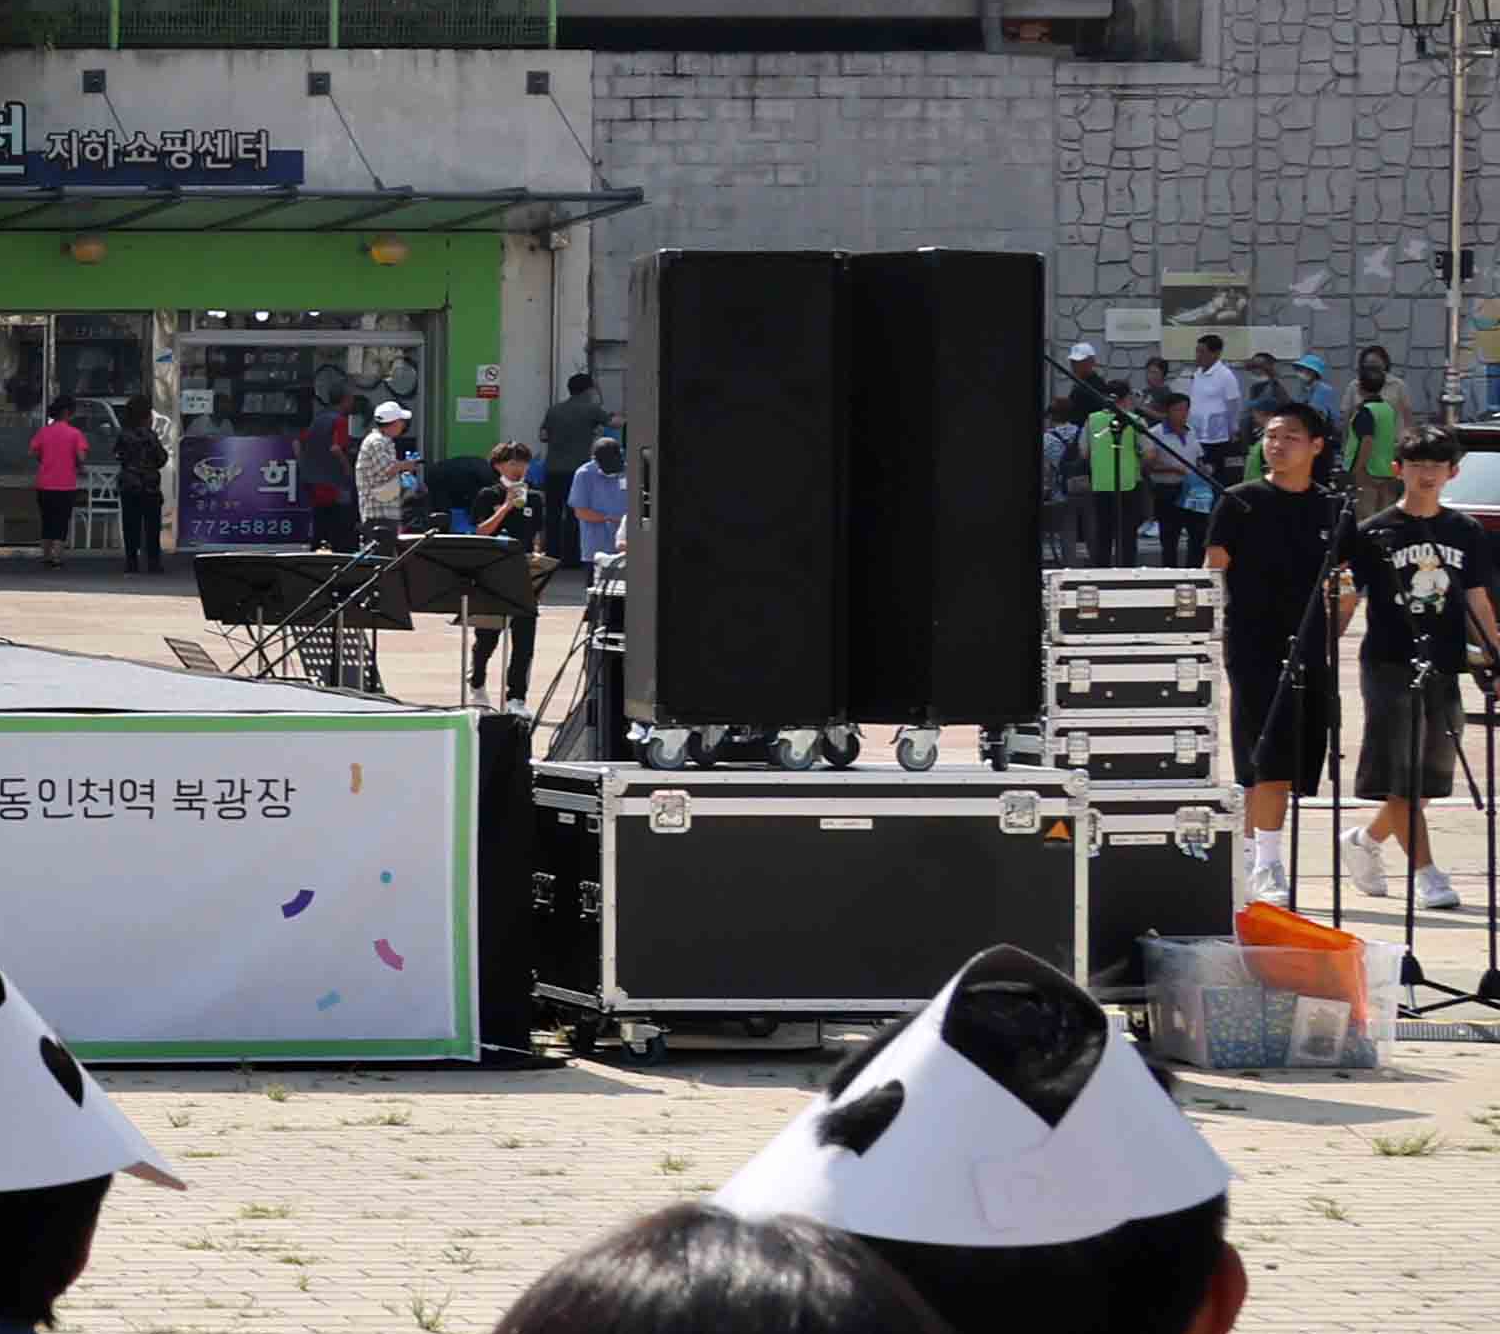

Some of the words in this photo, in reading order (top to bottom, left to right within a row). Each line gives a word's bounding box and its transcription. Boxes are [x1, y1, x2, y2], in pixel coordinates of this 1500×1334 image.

[47, 129, 270, 171] 지하쇼핑센터
[191, 518, 294, 536] 772-5828
[172, 777, 297, 821] 북광장
